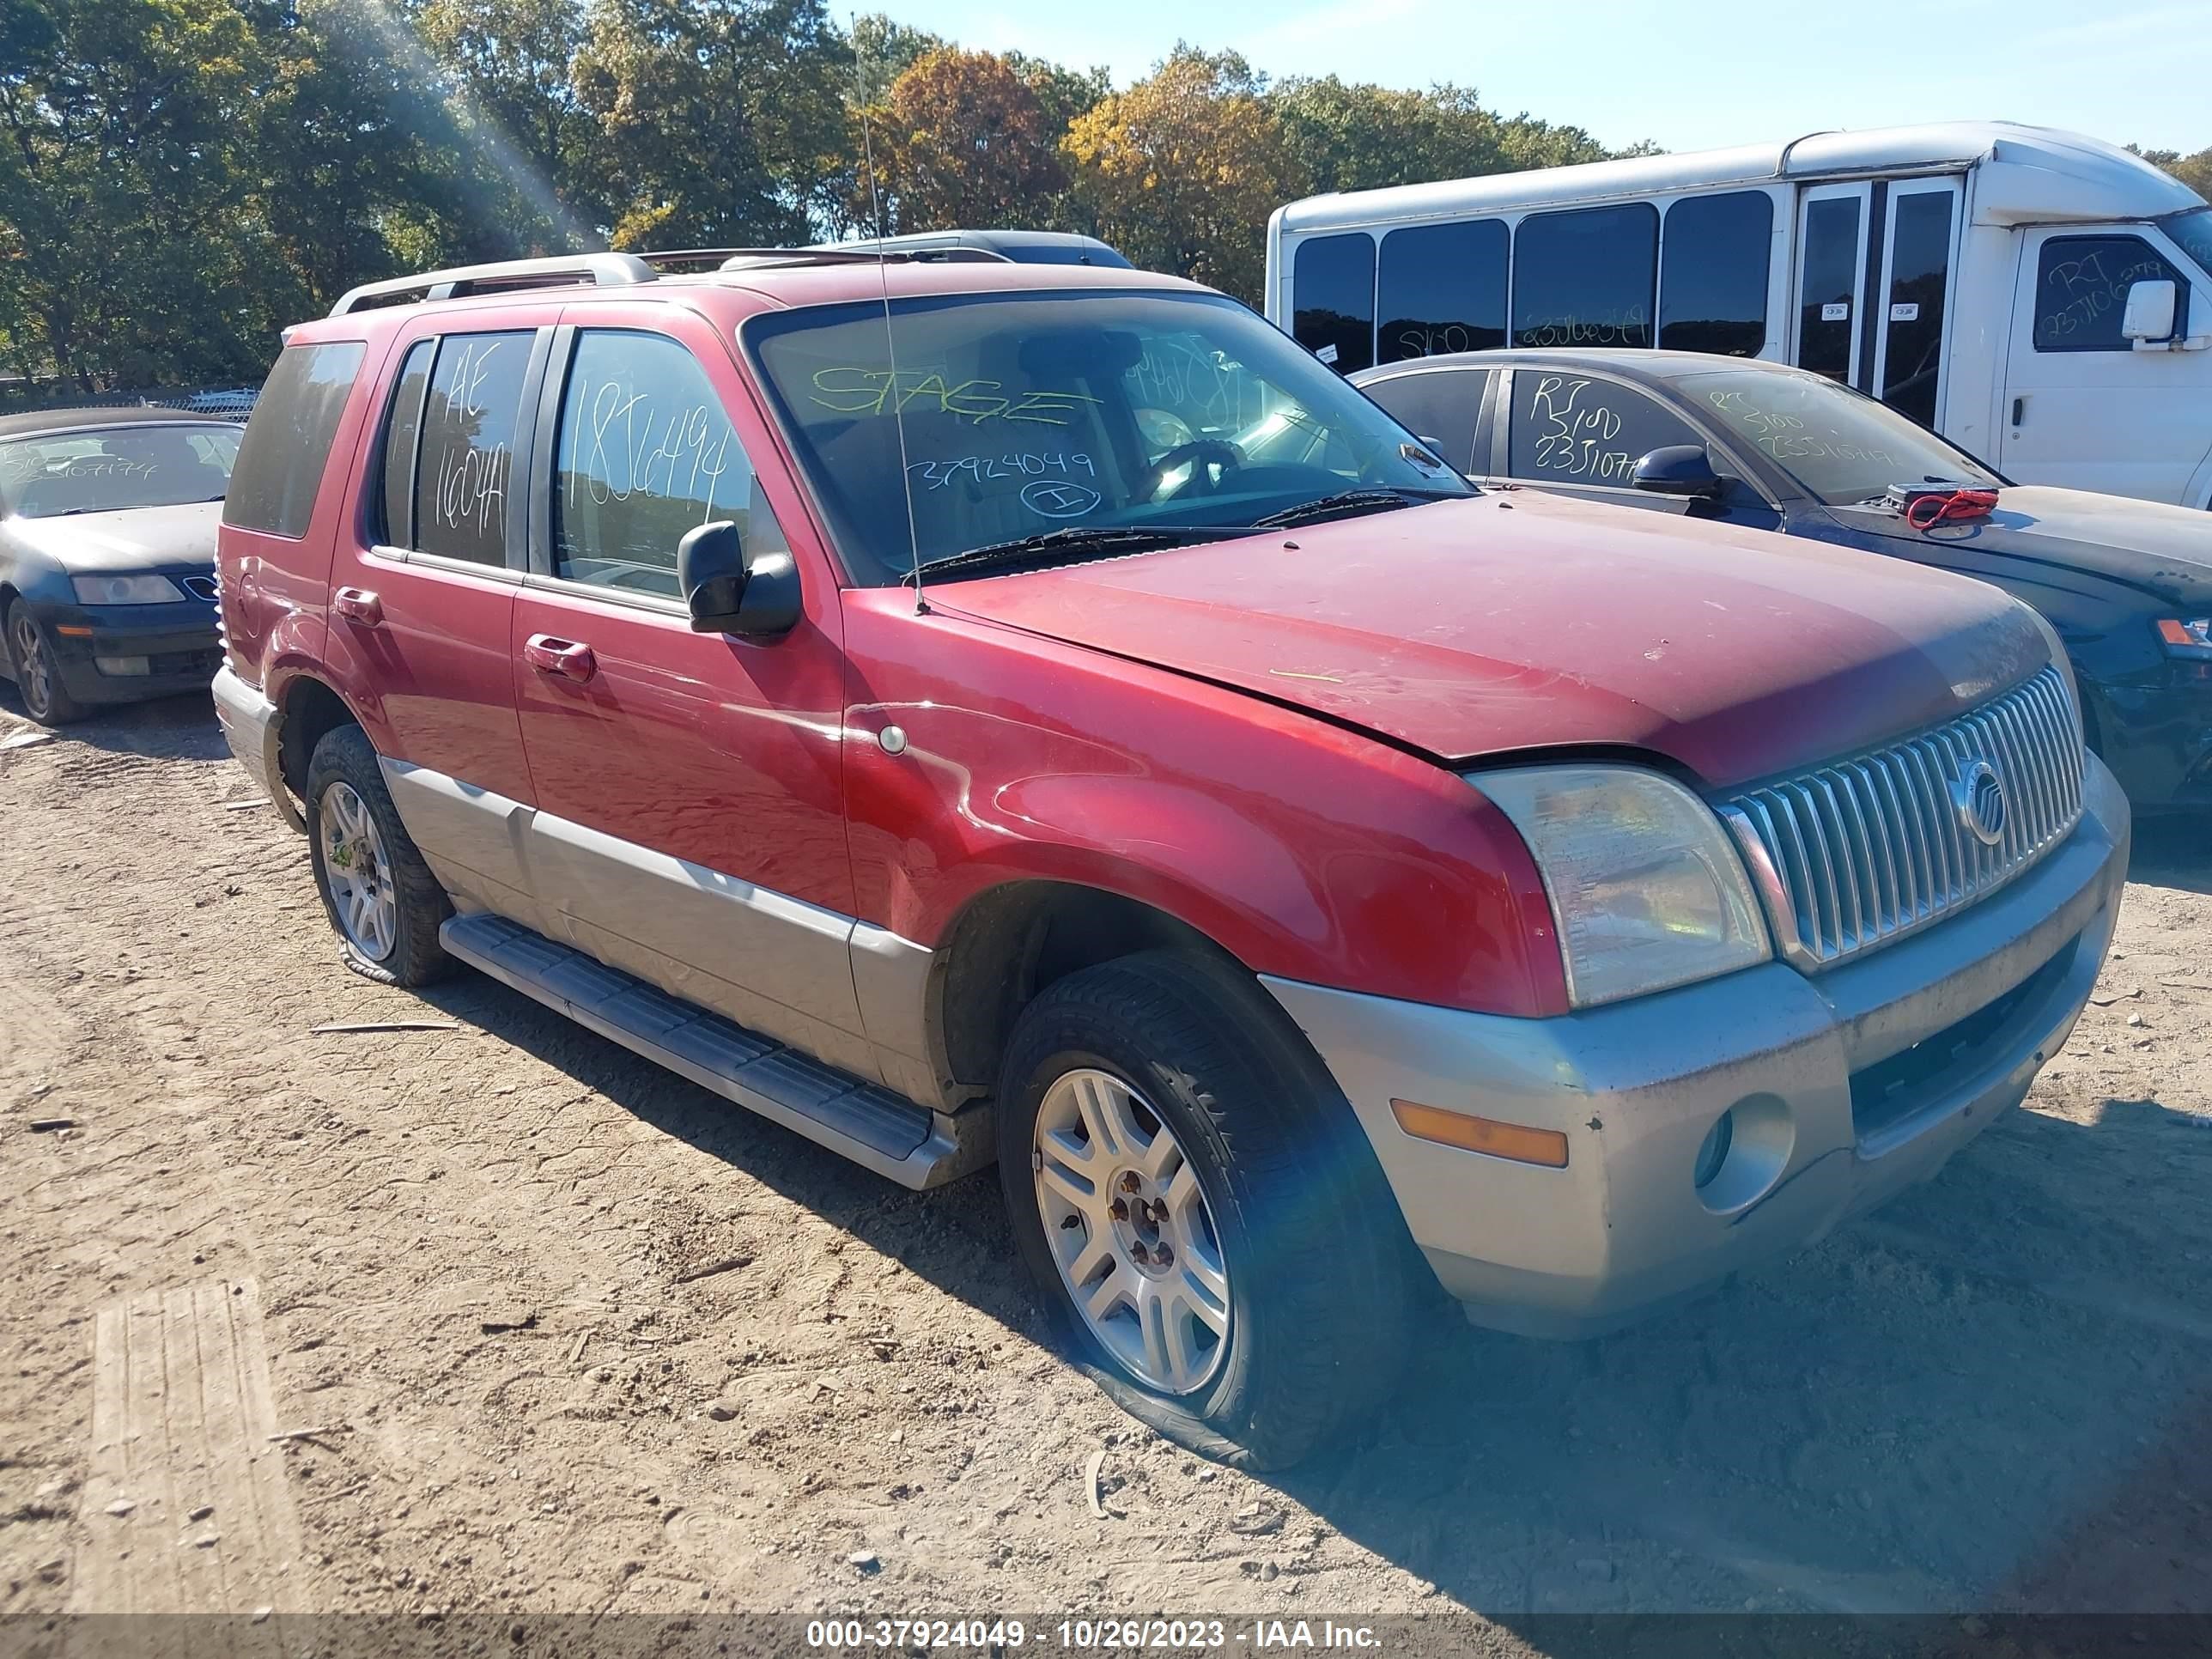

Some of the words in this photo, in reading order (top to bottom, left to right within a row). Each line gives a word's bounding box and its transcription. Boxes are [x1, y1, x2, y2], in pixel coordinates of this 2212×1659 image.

[444, 342, 501, 424] AE
[808, 368, 1103, 425] STAGE
[907, 453, 1095, 490] 37924049
